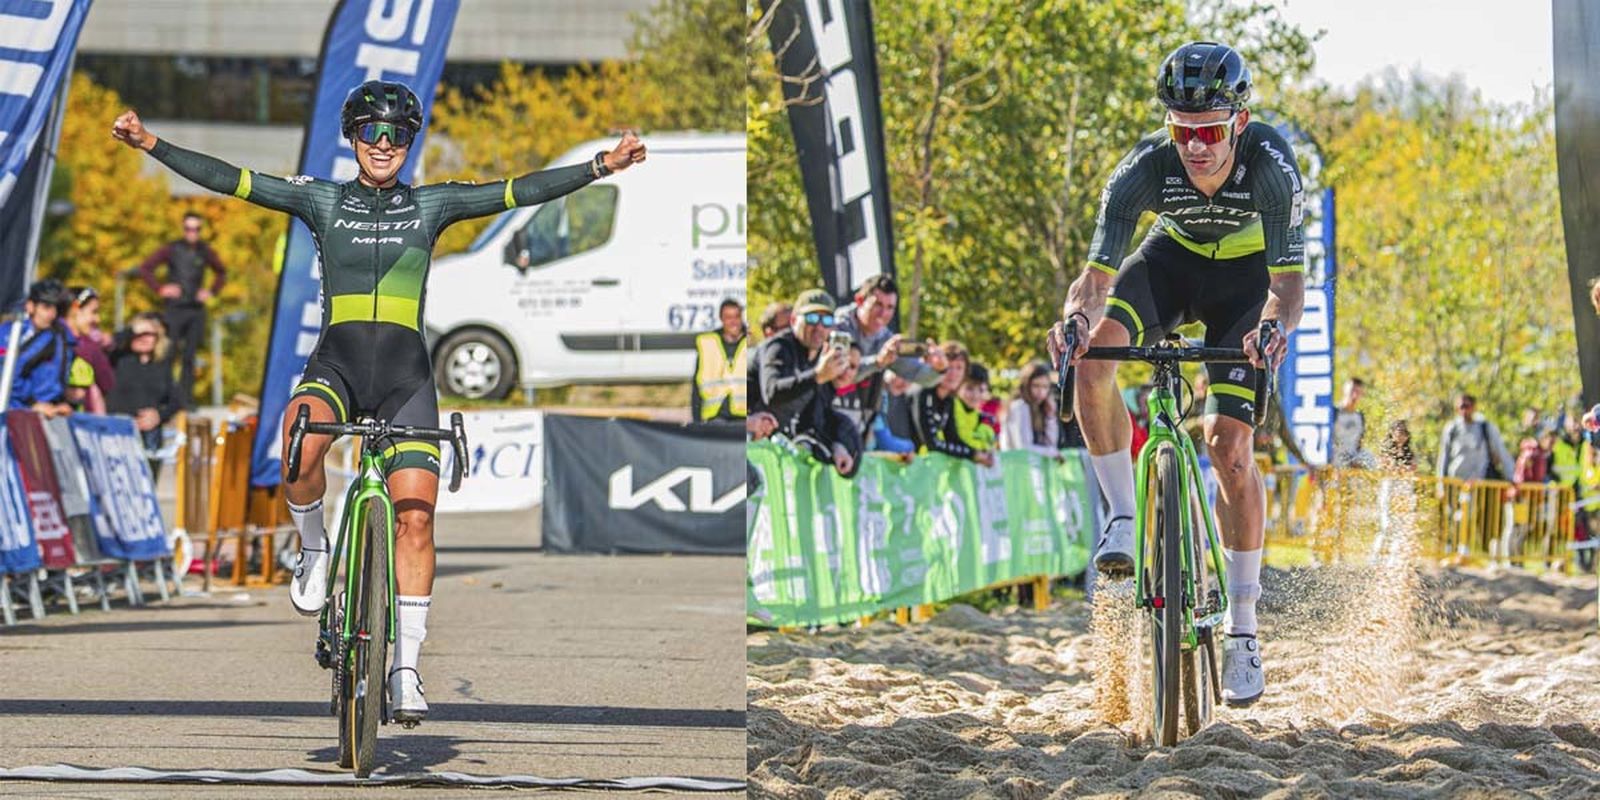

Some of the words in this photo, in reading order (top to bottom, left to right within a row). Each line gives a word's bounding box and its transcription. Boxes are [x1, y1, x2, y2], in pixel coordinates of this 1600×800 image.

[333, 218, 421, 231] NESTA
[351, 236, 403, 245] MMR
[668, 303, 716, 330] 673
